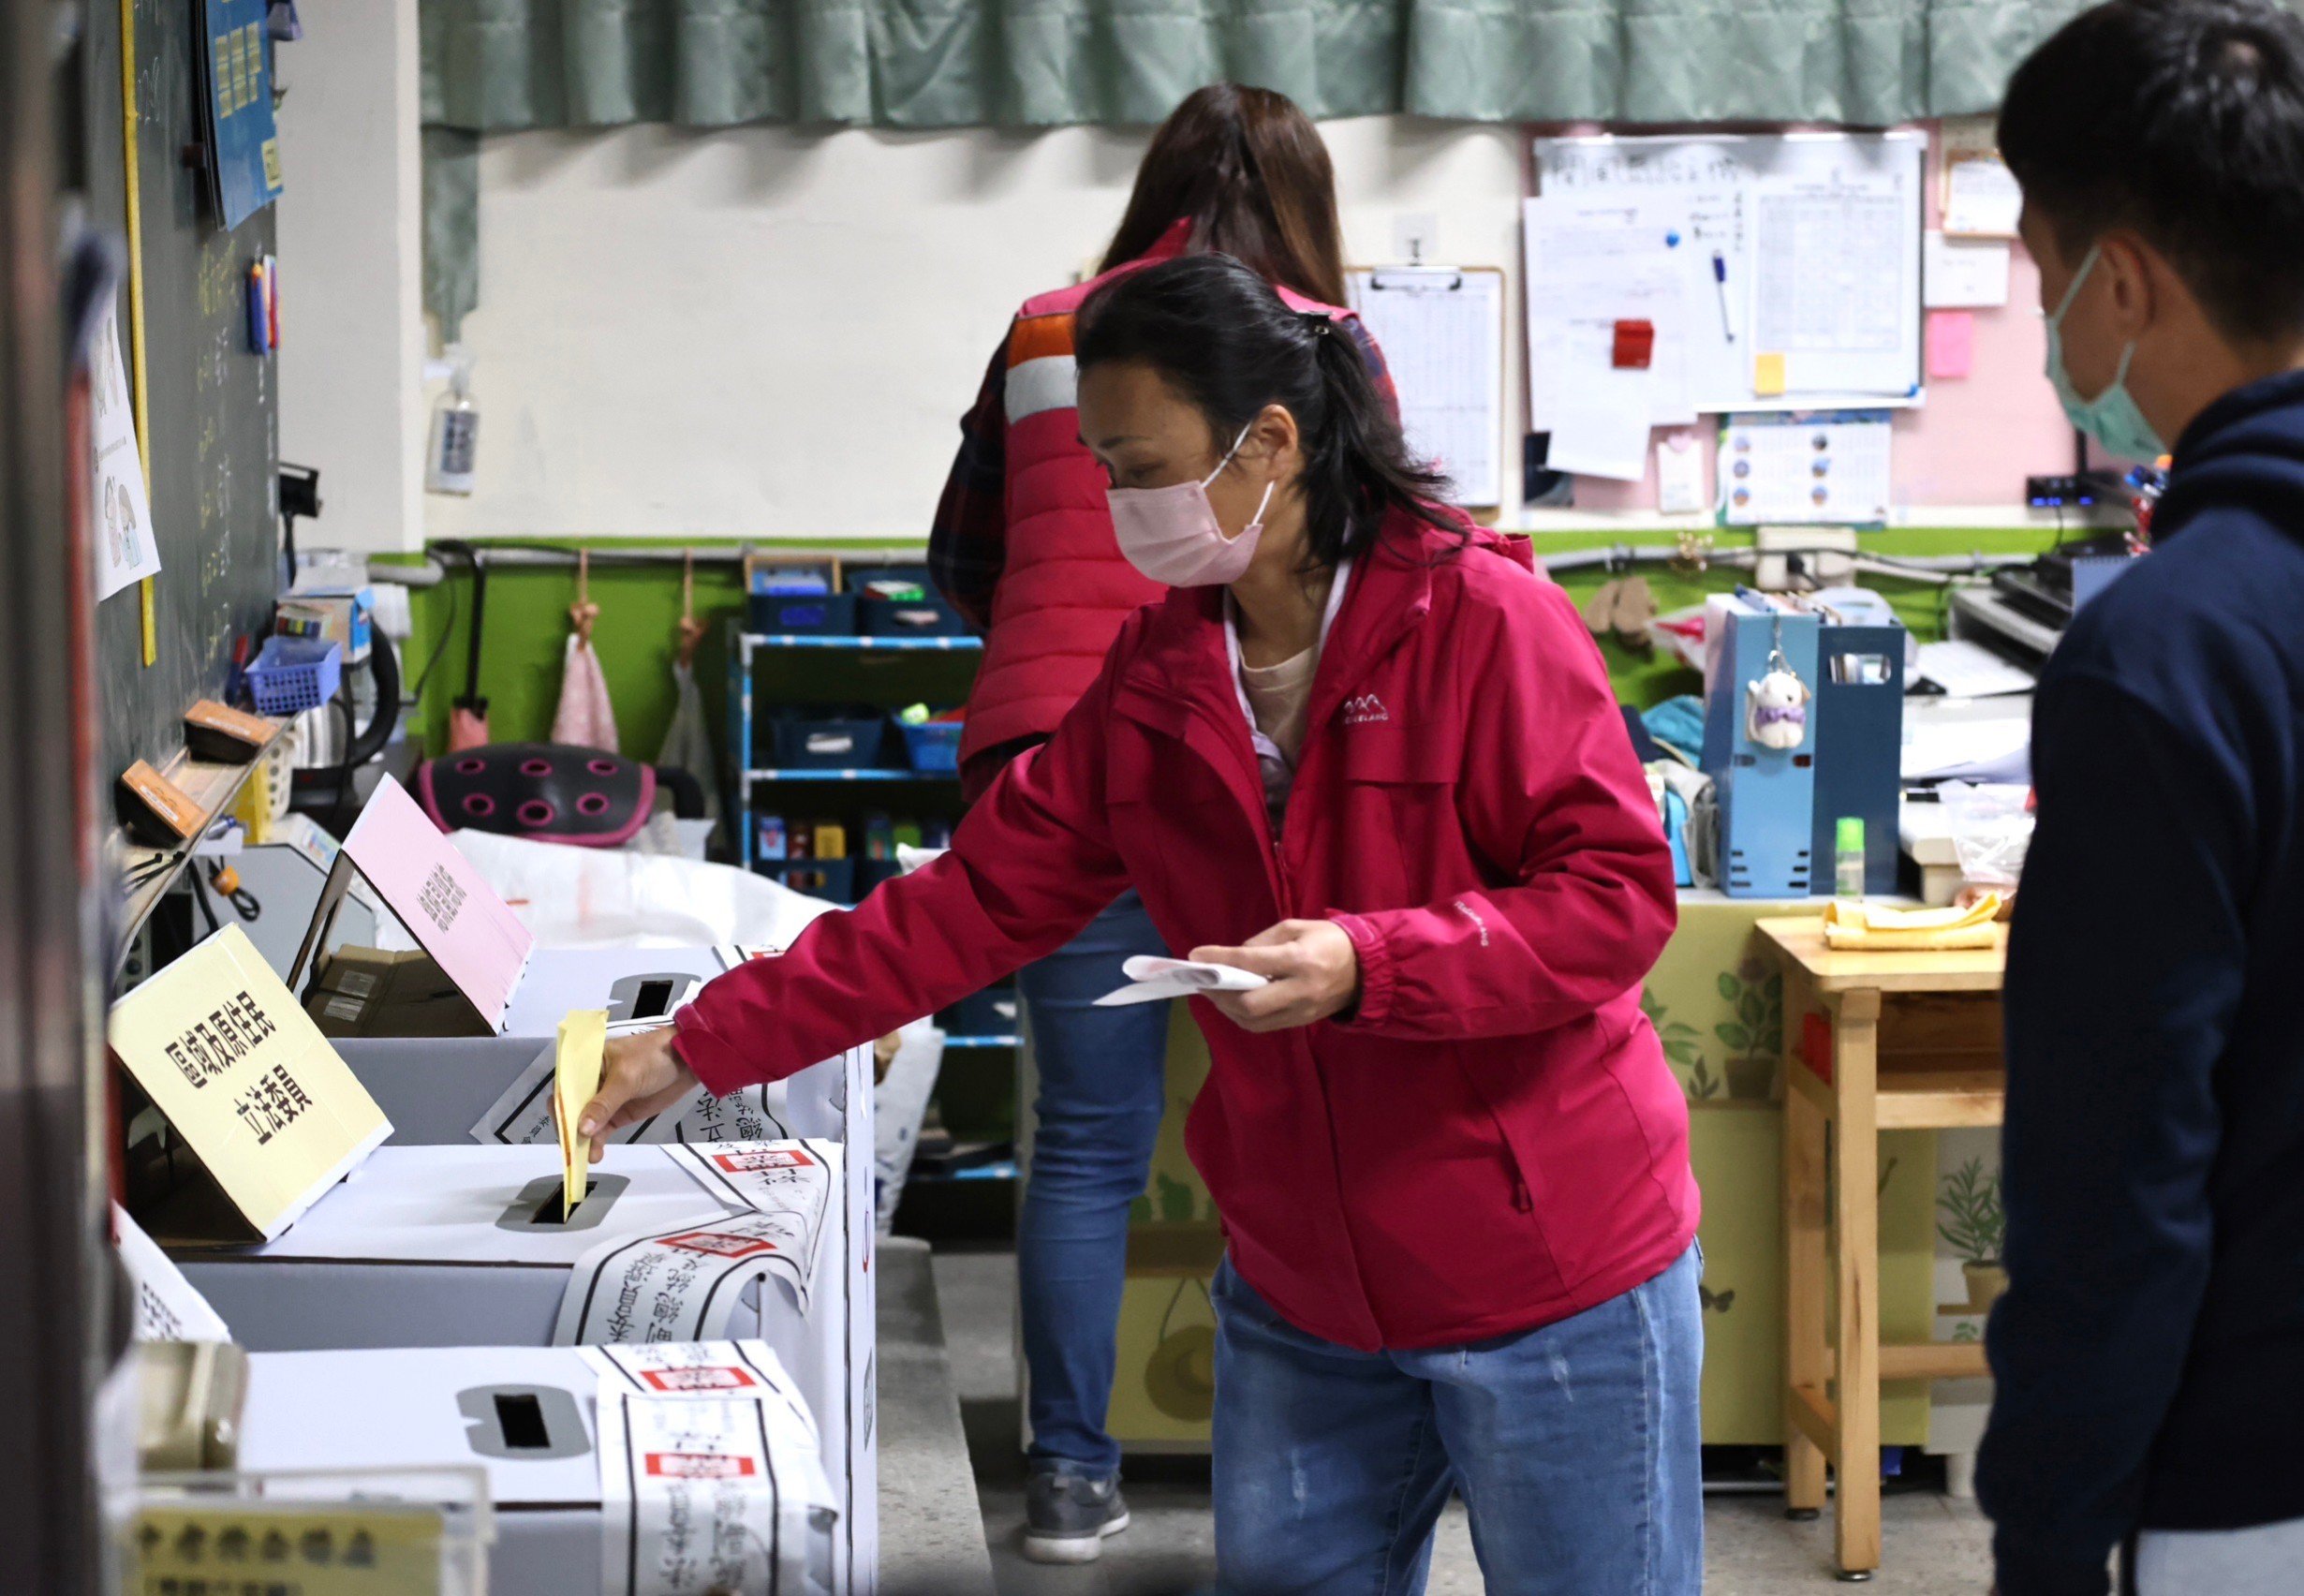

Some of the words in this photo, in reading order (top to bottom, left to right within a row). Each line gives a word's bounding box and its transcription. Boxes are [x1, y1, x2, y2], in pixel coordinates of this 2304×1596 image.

[164, 990, 276, 1089] 區域及原住民
[233, 1064, 313, 1145] 立法委員
[696, 1090, 726, 1143] 立法
